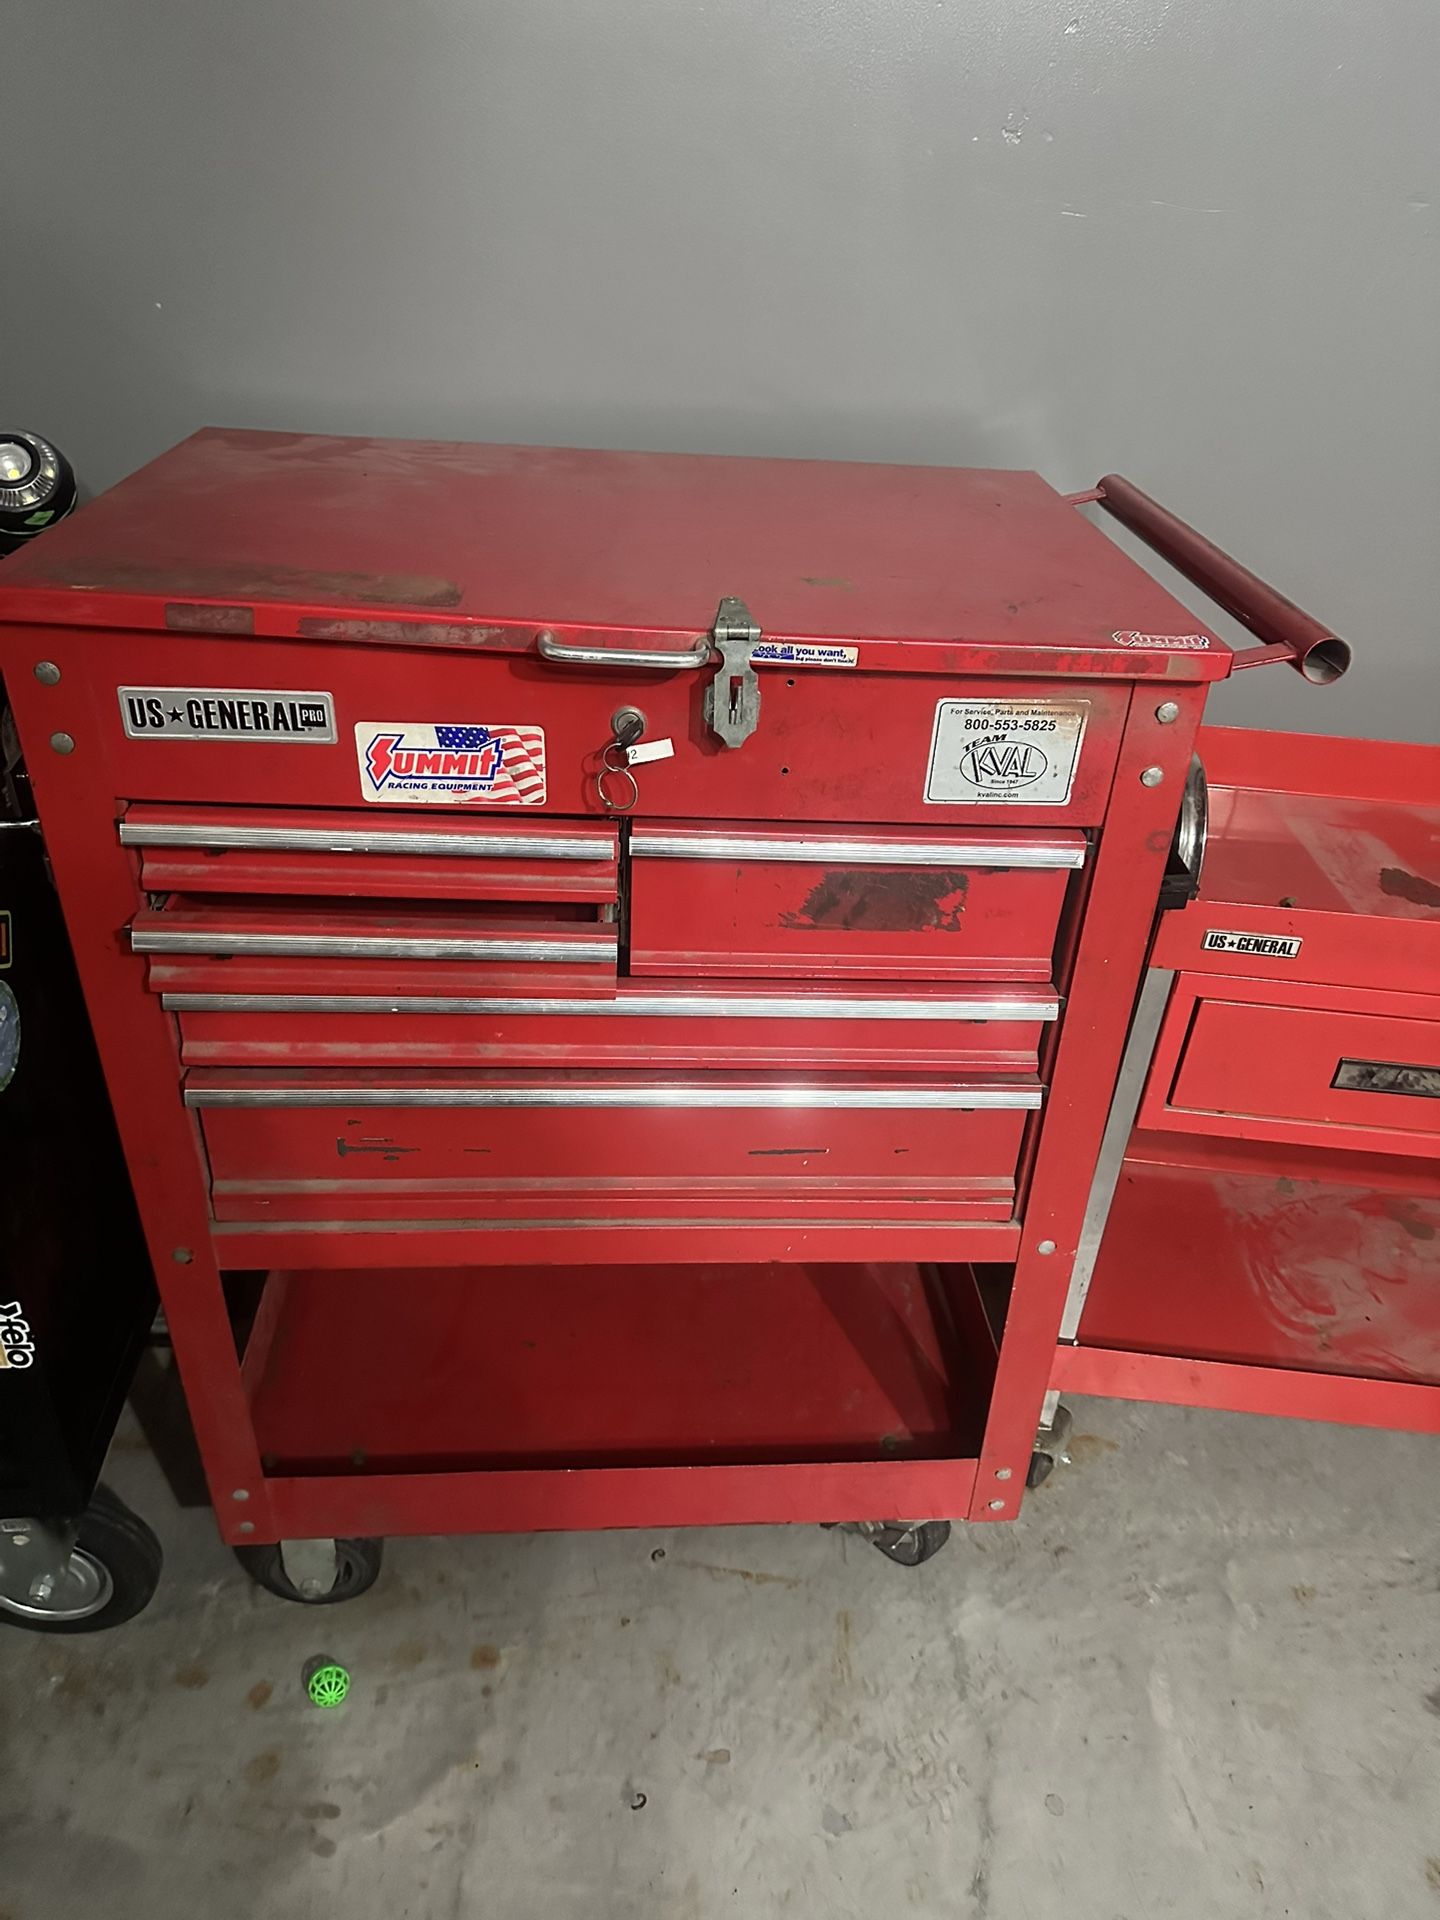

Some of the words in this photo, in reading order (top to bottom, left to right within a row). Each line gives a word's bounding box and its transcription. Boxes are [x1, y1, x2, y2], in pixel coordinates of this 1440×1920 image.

[781, 645, 794, 655] all
[796, 647, 815, 657] you
[817, 648, 847, 659] want,
[127, 697, 166, 729] US
[186, 698, 306, 732] GENERAL
[301, 710, 324, 723] PRO
[950, 708, 963, 716] For
[964, 708, 994, 717] Service,
[994, 708, 1014, 716] Parts
[1015, 709, 1029, 717] and
[1030, 709, 1077, 718] Maintenance
[964, 718, 1058, 732] 800-553-5825
[962, 733, 1008, 753] TEAM
[971, 746, 1038, 783] KVAL
[387, 781, 428, 791] RACING
[431, 782, 493, 792] EQUIPMENT
[977, 791, 1019, 799] kvalinc.com
[1208, 934, 1227, 948] US
[1236, 937, 1296, 956] GENERAL
